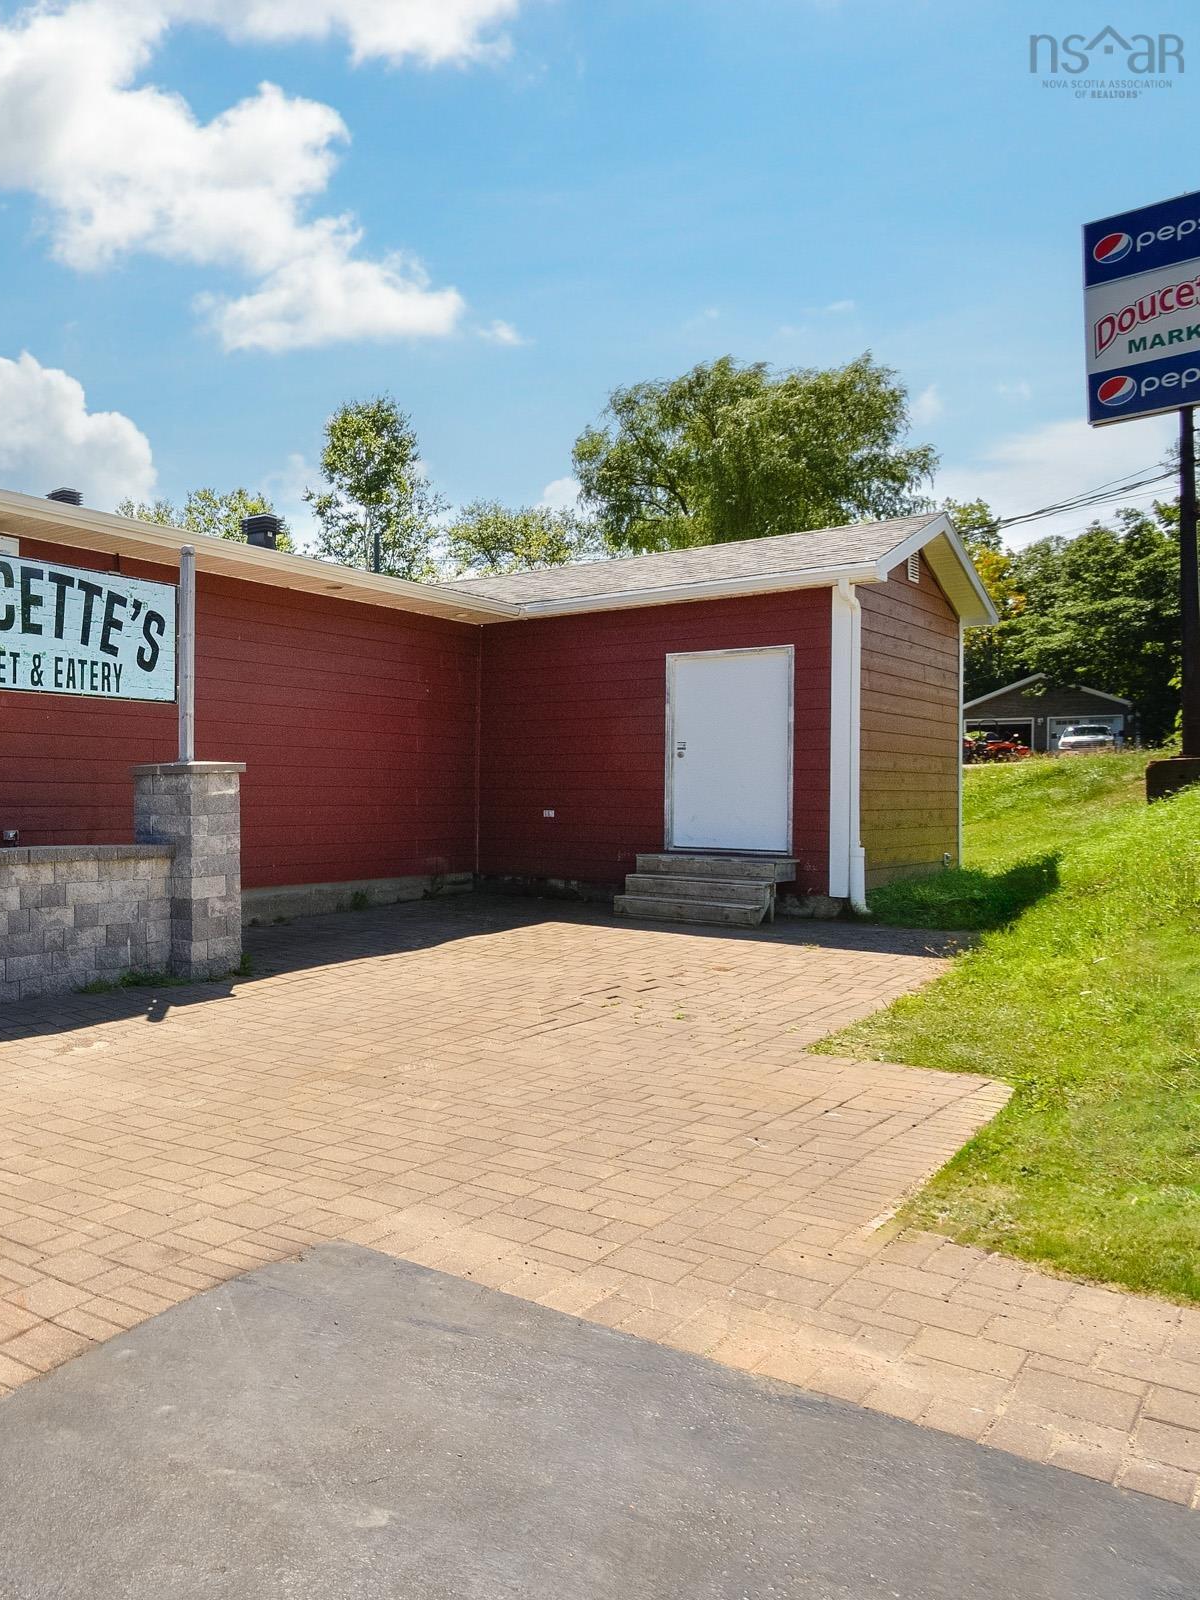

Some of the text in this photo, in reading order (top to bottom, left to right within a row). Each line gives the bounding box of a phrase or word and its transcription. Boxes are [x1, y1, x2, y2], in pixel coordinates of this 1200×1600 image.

[1136, 218, 1200, 252] pep
[30, 653, 44, 686] &
[54, 656, 123, 693] EATERY
